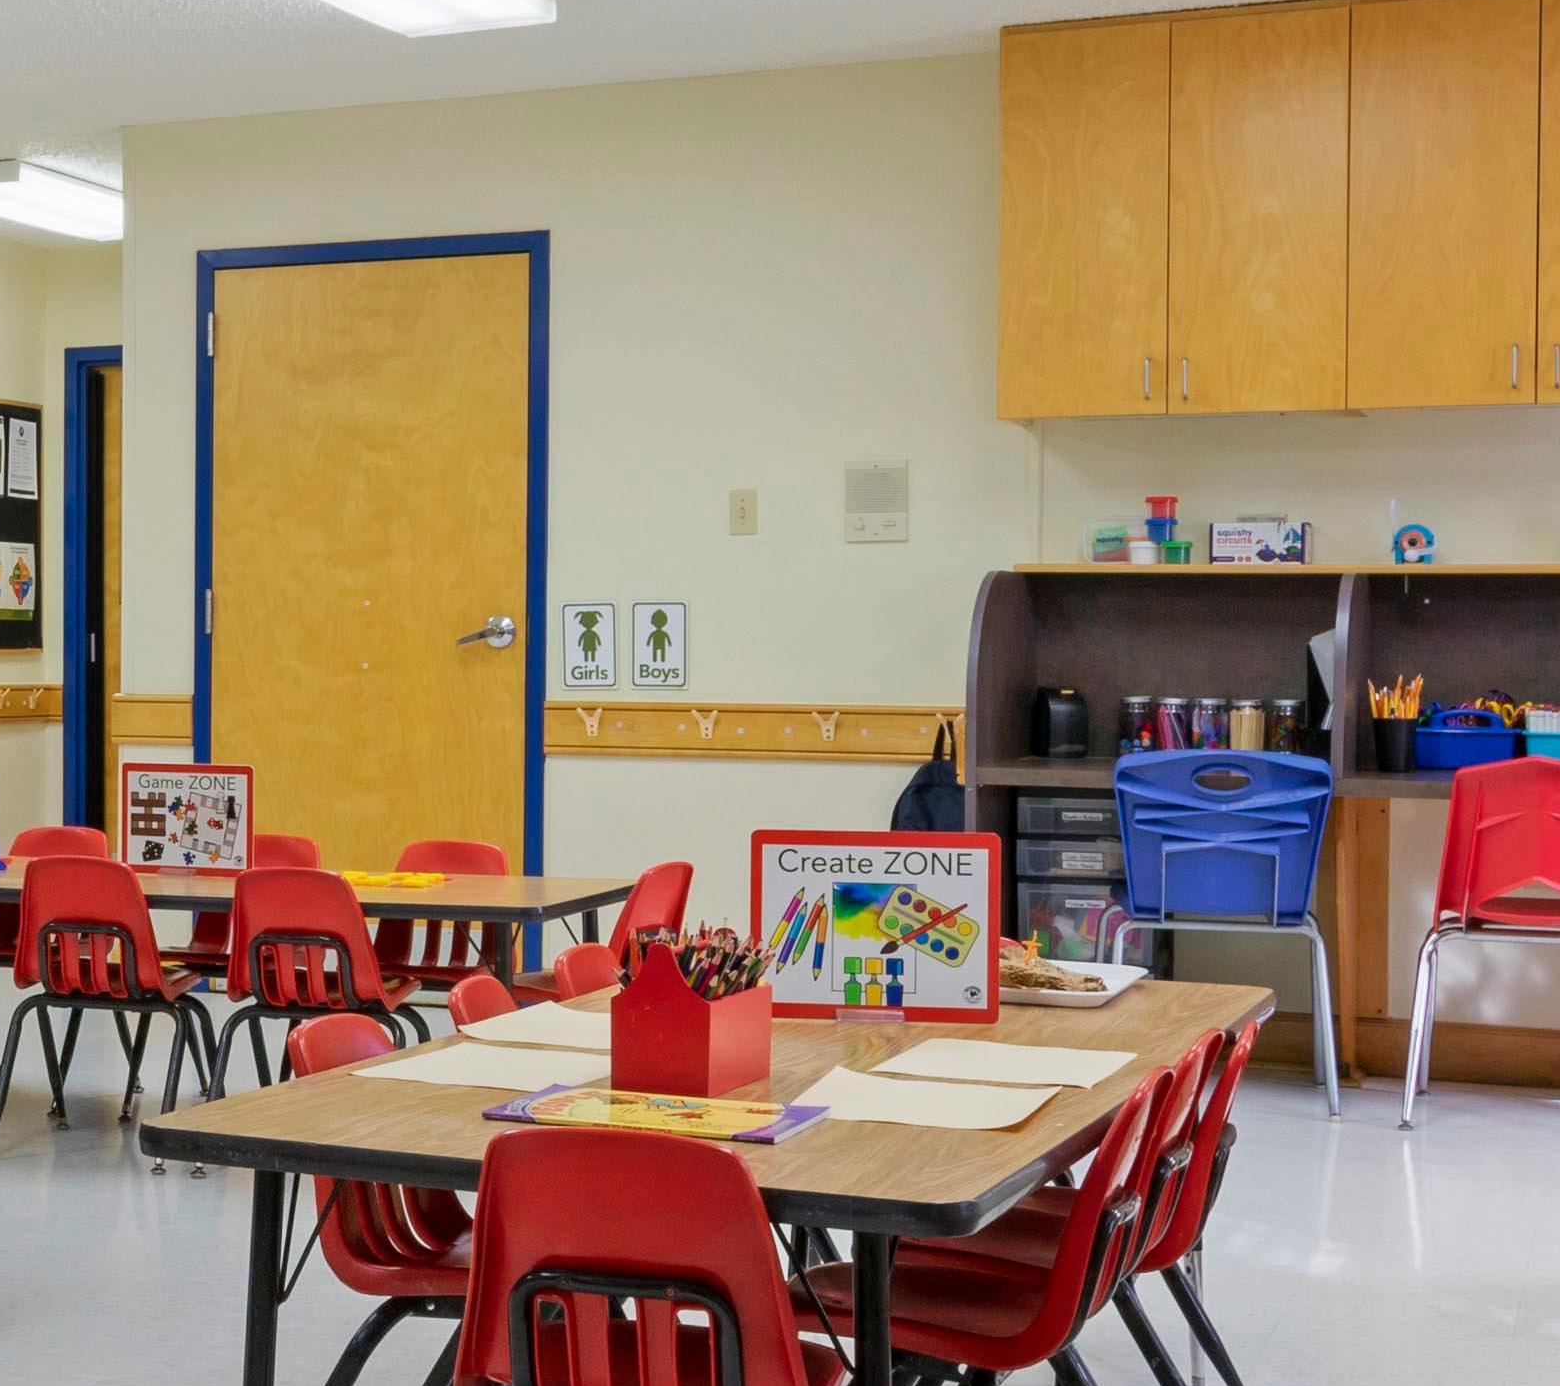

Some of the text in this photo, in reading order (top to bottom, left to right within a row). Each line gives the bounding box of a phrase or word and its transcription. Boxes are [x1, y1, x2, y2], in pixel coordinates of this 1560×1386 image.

[1217, 529, 1253, 537] squishy
[571, 664, 608, 680] Girls
[639, 664, 679, 683] Boys
[138, 774, 236, 791] Game ZONE
[778, 848, 973, 877] Create ZONE
